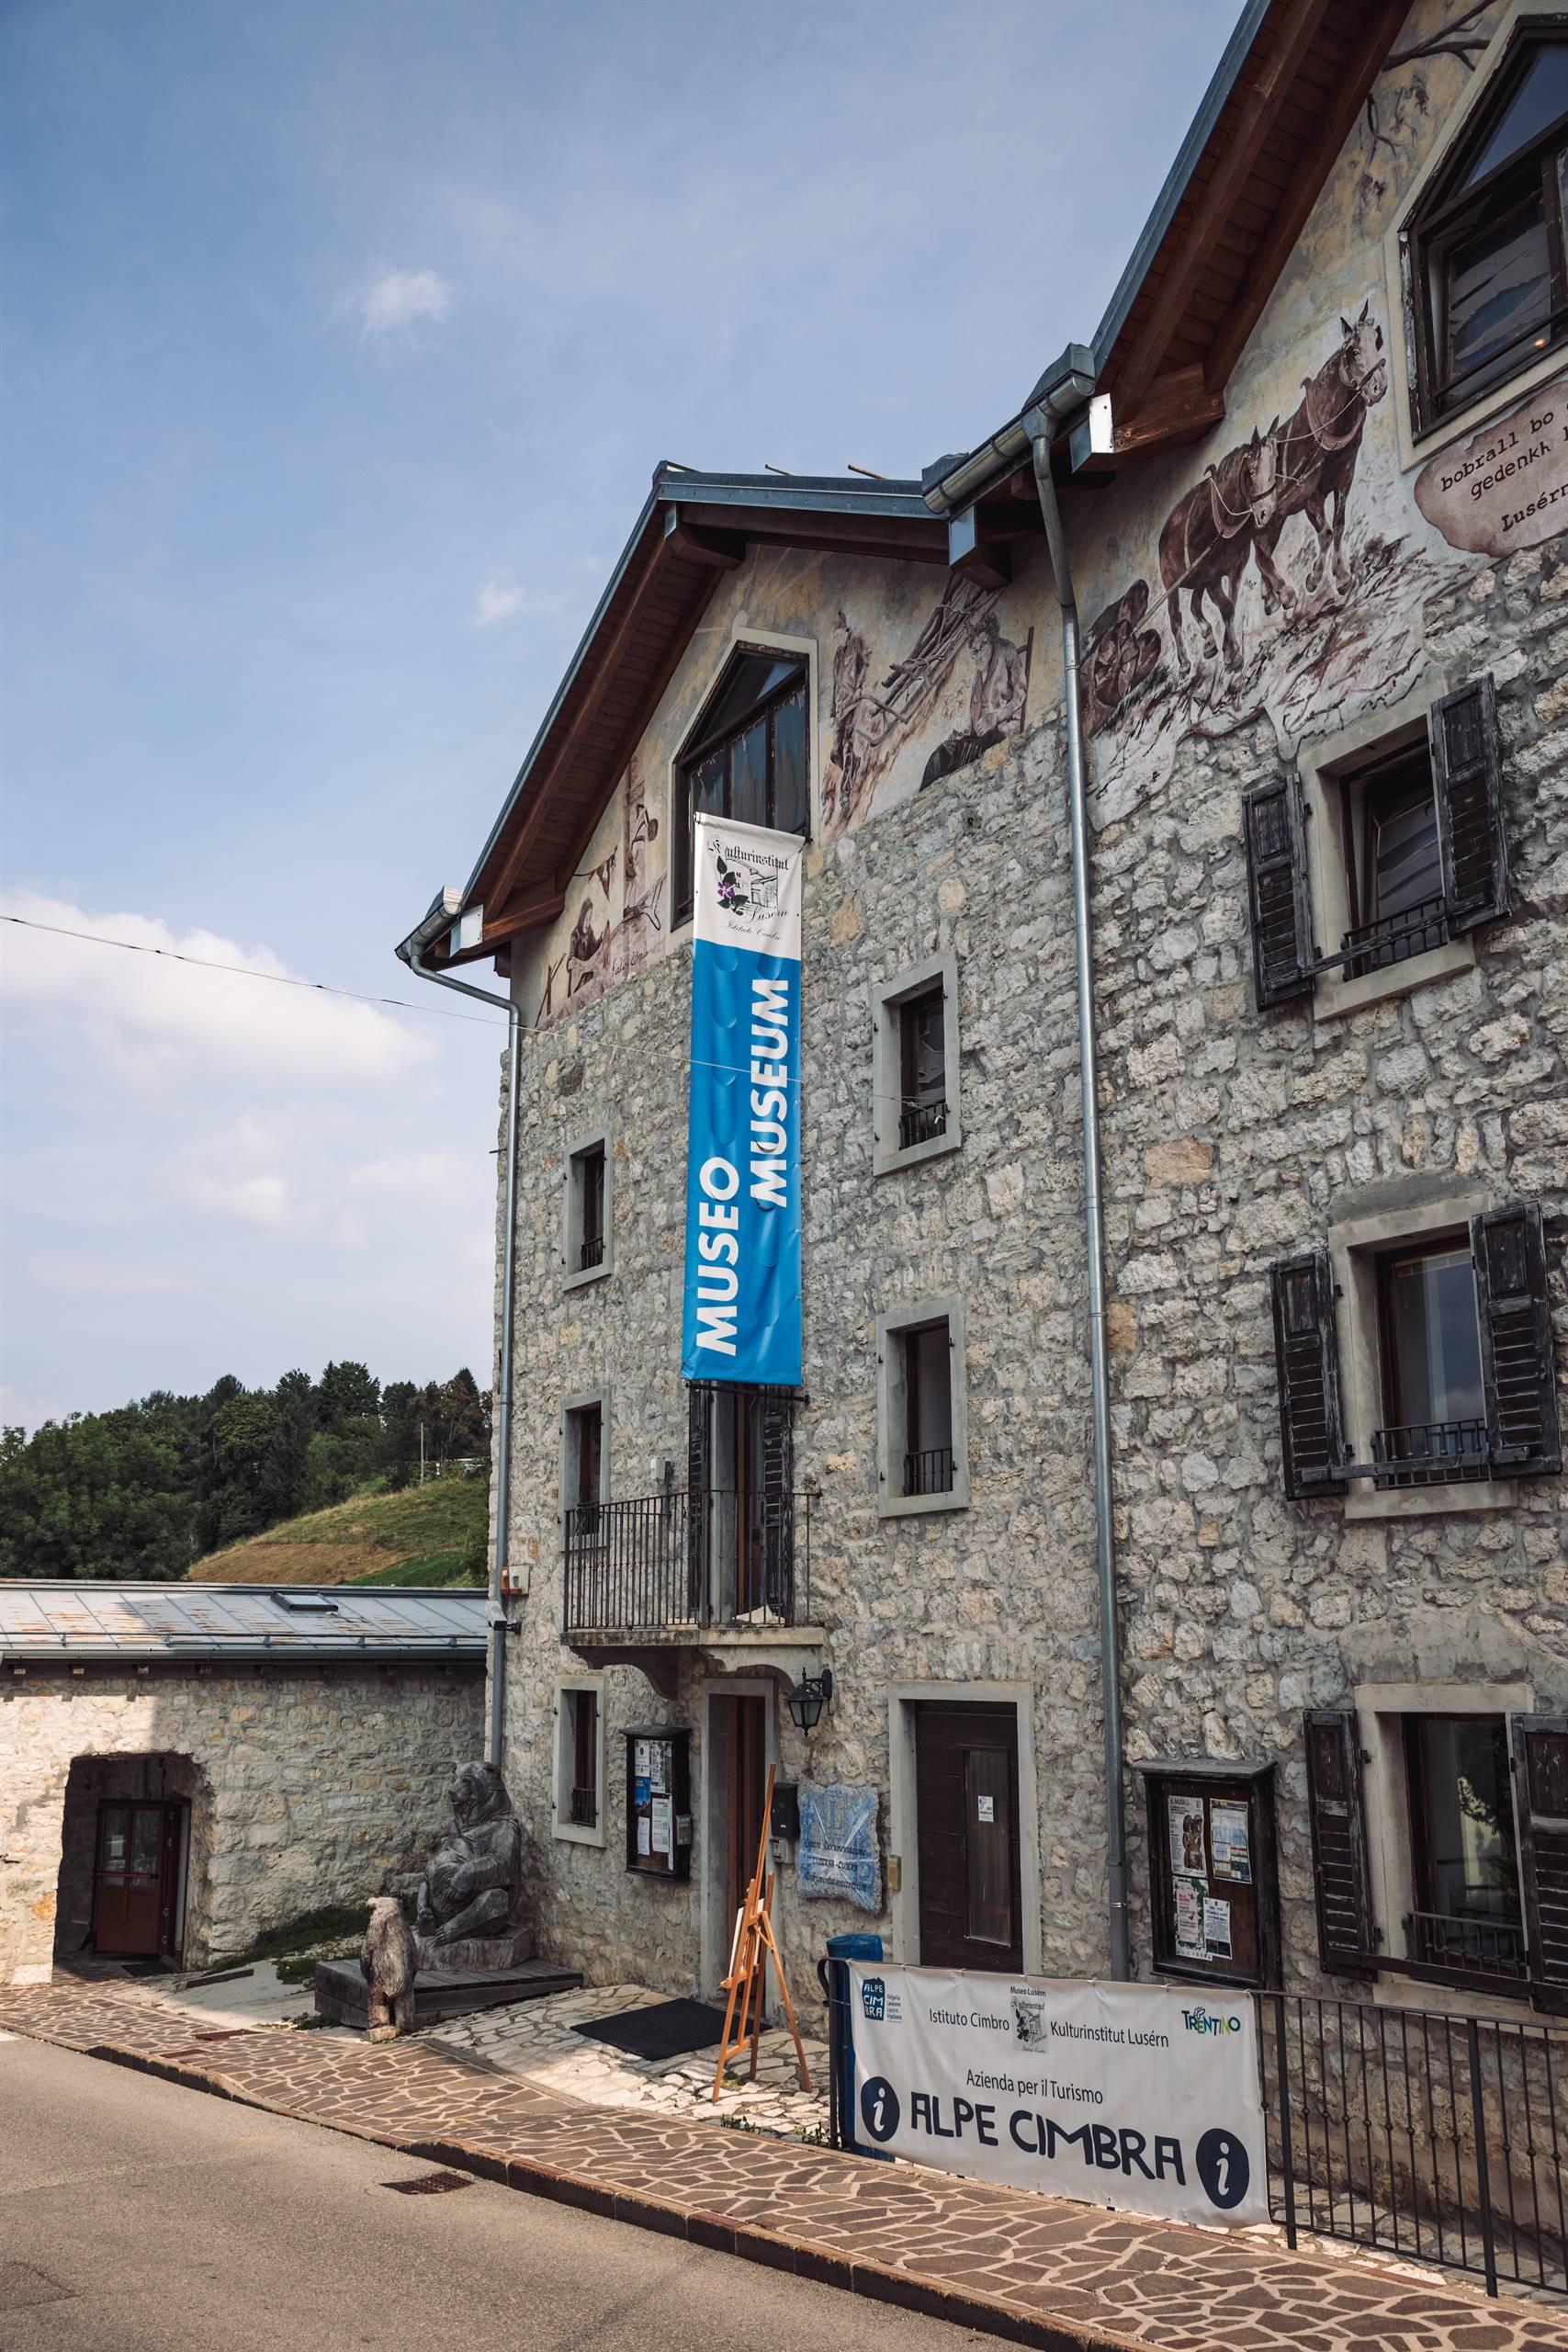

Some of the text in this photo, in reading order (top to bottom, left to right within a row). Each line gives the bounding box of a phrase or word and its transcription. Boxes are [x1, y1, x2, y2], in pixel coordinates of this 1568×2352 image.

[1440, 411, 1555, 492] bobrall bo
[1470, 440, 1551, 501] gedenkh
[750, 978, 789, 1208] MUSEUM
[696, 1157, 739, 1356] MUSEO
[863, 1995, 884, 2007] CIM
[864, 1984, 883, 1993] ALPE
[1010, 1986, 1027, 1995] Museo
[865, 2007, 883, 2018] BRA
[930, 2008, 1010, 2030] Istituto Cimbro
[1181, 2010, 1240, 2036] TRENTINO
[1051, 2021, 1125, 2044] Kulturinstitut
[1128, 2029, 1169, 2048] Lusérn
[966, 2069, 1103, 2104] Azienda per il Turismo
[911, 2091, 1187, 2186] ALPE CIMBRA
